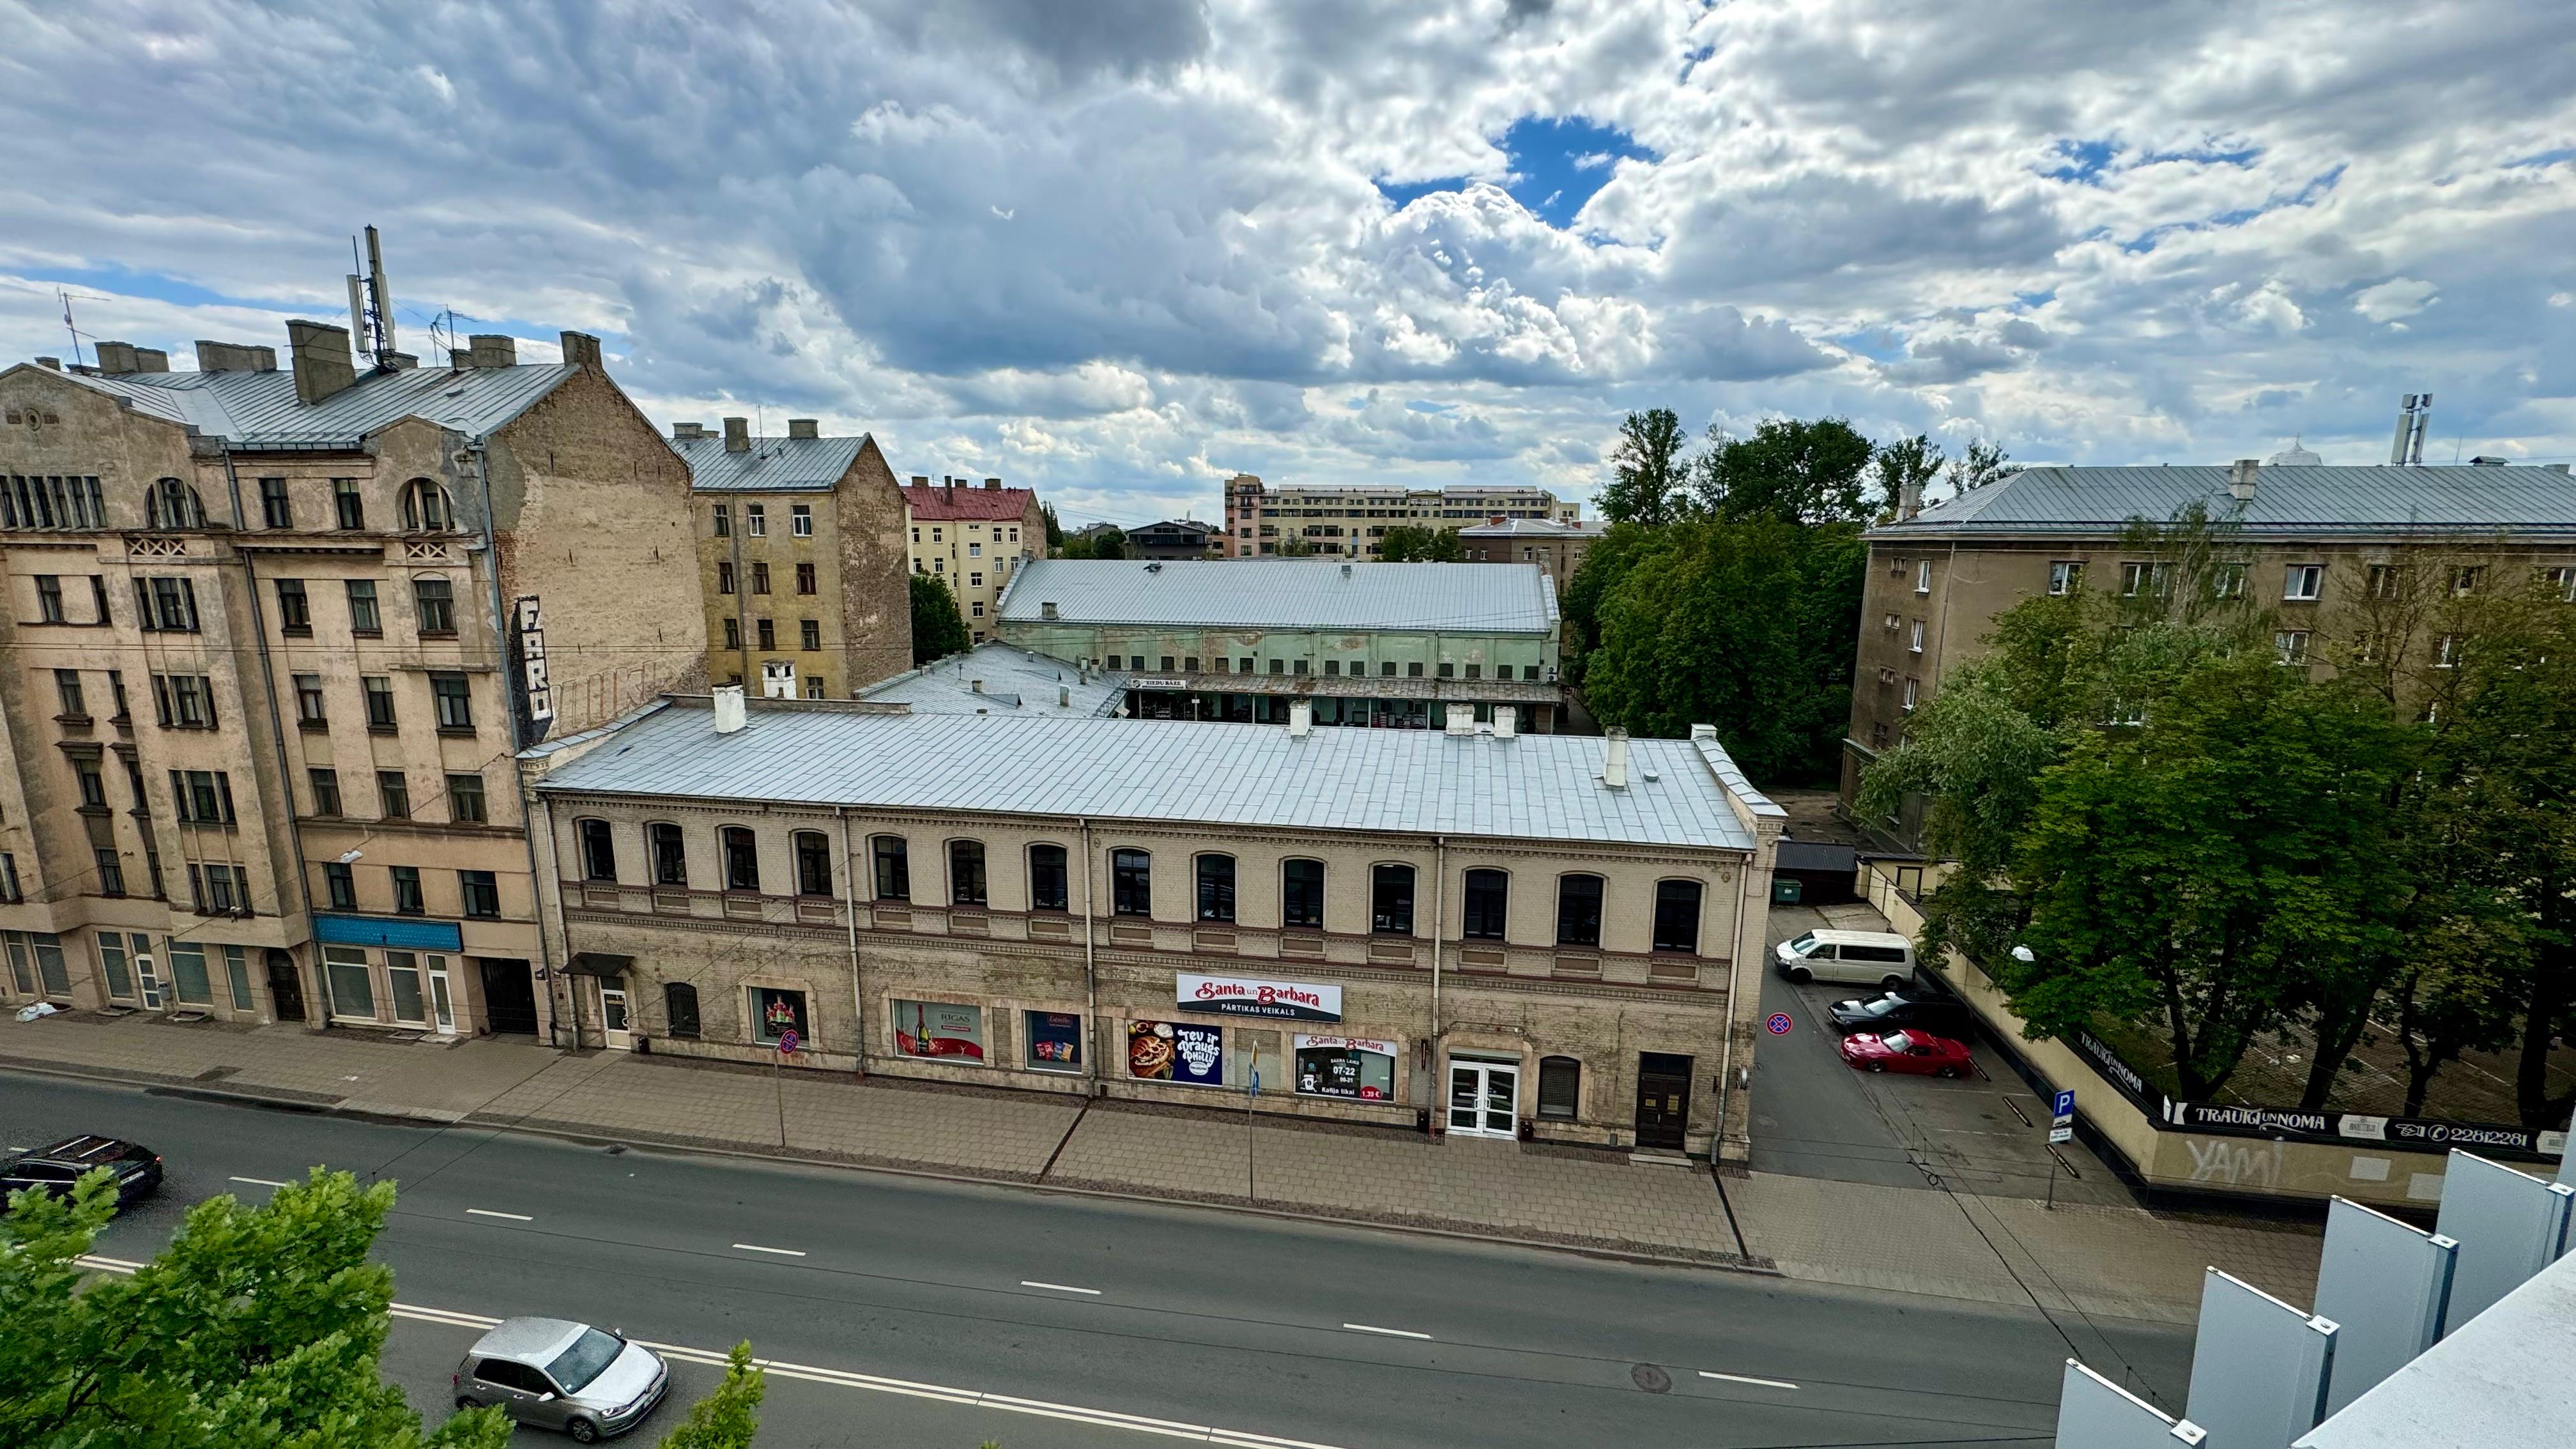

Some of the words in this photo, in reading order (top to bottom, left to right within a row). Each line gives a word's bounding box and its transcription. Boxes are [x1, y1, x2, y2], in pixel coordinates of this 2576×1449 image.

[1195, 982, 1246, 999] Santa
[1257, 986, 1320, 1008] Barbara
[1221, 1002, 1261, 1013] PĀRTIKAS
[1262, 1006, 1295, 1016] VEIKALS
[1207, 1032, 1219, 1045] ir
[1306, 1036, 1338, 1046] Santa
[1345, 1038, 1384, 1052] Barbara
[2080, 1031, 2112, 1066] TRAUKI
[2117, 1062, 2142, 1092] NOMA
[1333, 1066, 1355, 1076] 07-22
[1321, 1087, 1339, 1095] Kafija
[2058, 1094, 2070, 1113] P
[2196, 1107, 2262, 1125] TRAUKI
[2262, 1113, 2276, 1121] UN
[2275, 1114, 2326, 1130] NOMA
[2450, 1127, 2527, 1147] 22812281
